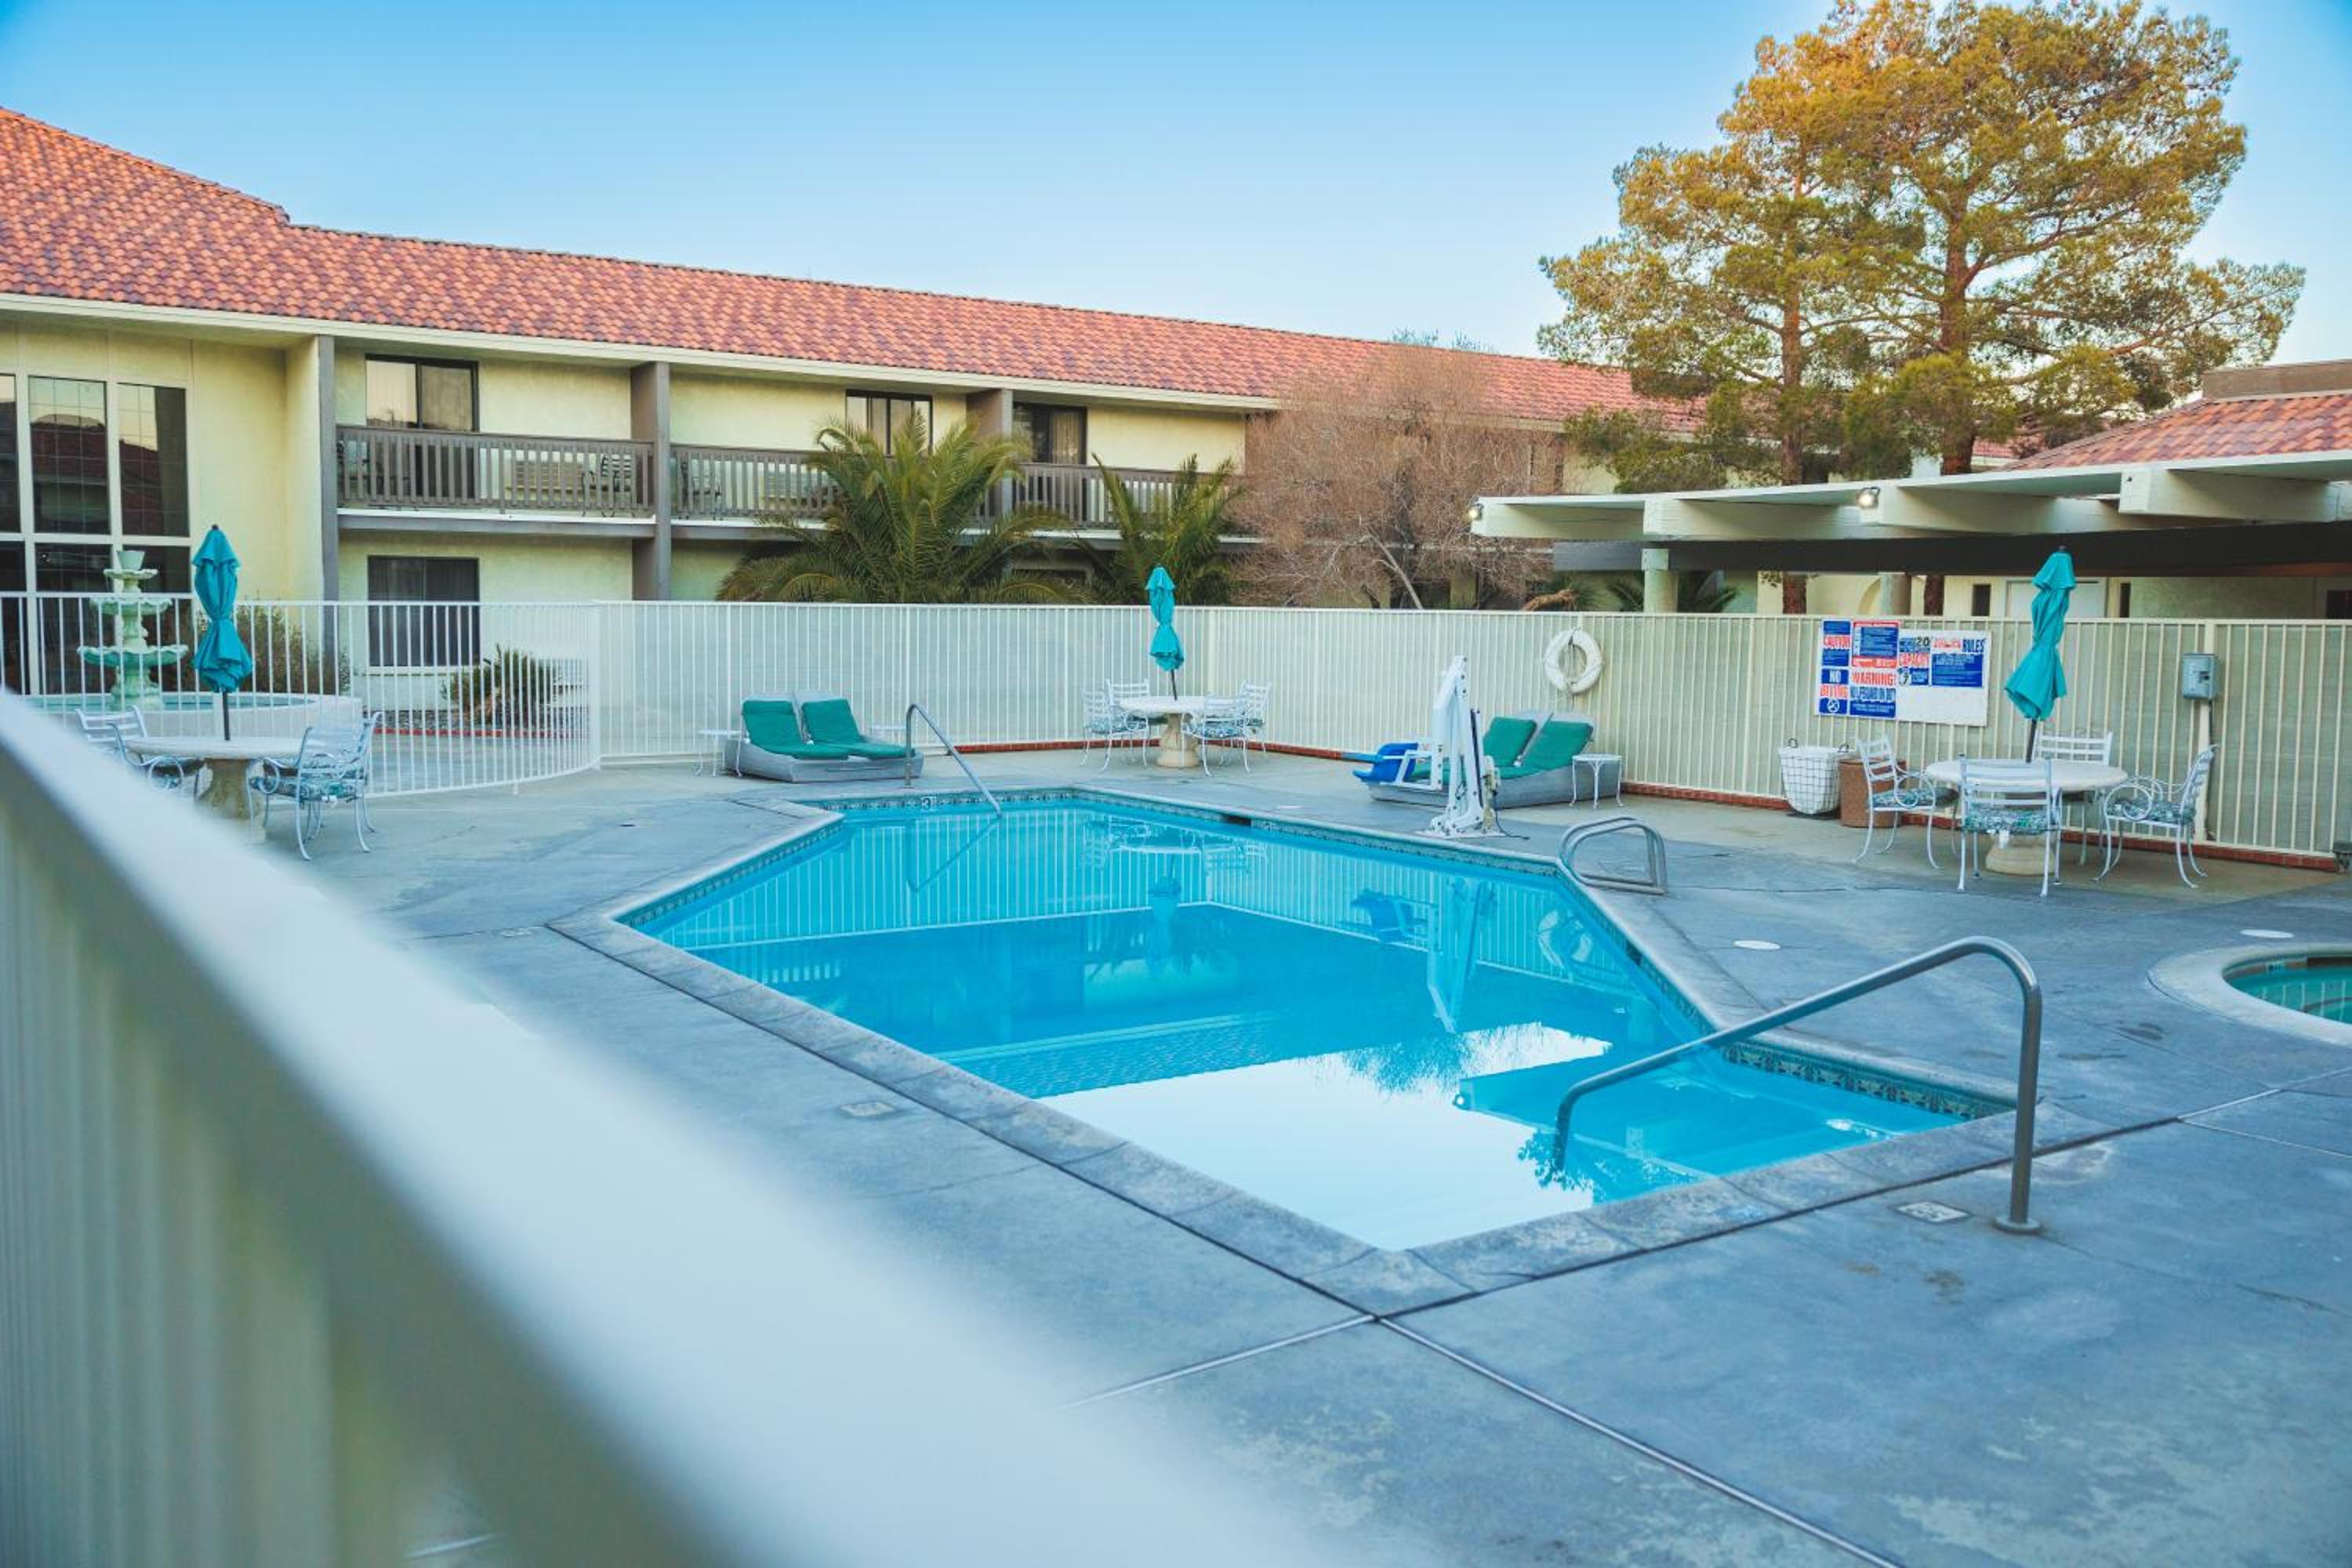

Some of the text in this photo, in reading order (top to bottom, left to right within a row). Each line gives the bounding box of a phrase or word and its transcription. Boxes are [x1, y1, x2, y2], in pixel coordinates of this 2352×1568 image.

[1917, 637, 1930, 647] 20
[1962, 639, 1985, 652] RULES
[1829, 670, 1841, 682] NO
[1852, 672, 1896, 686] WARNING!
[1820, 684, 1848, 698] DIVING
